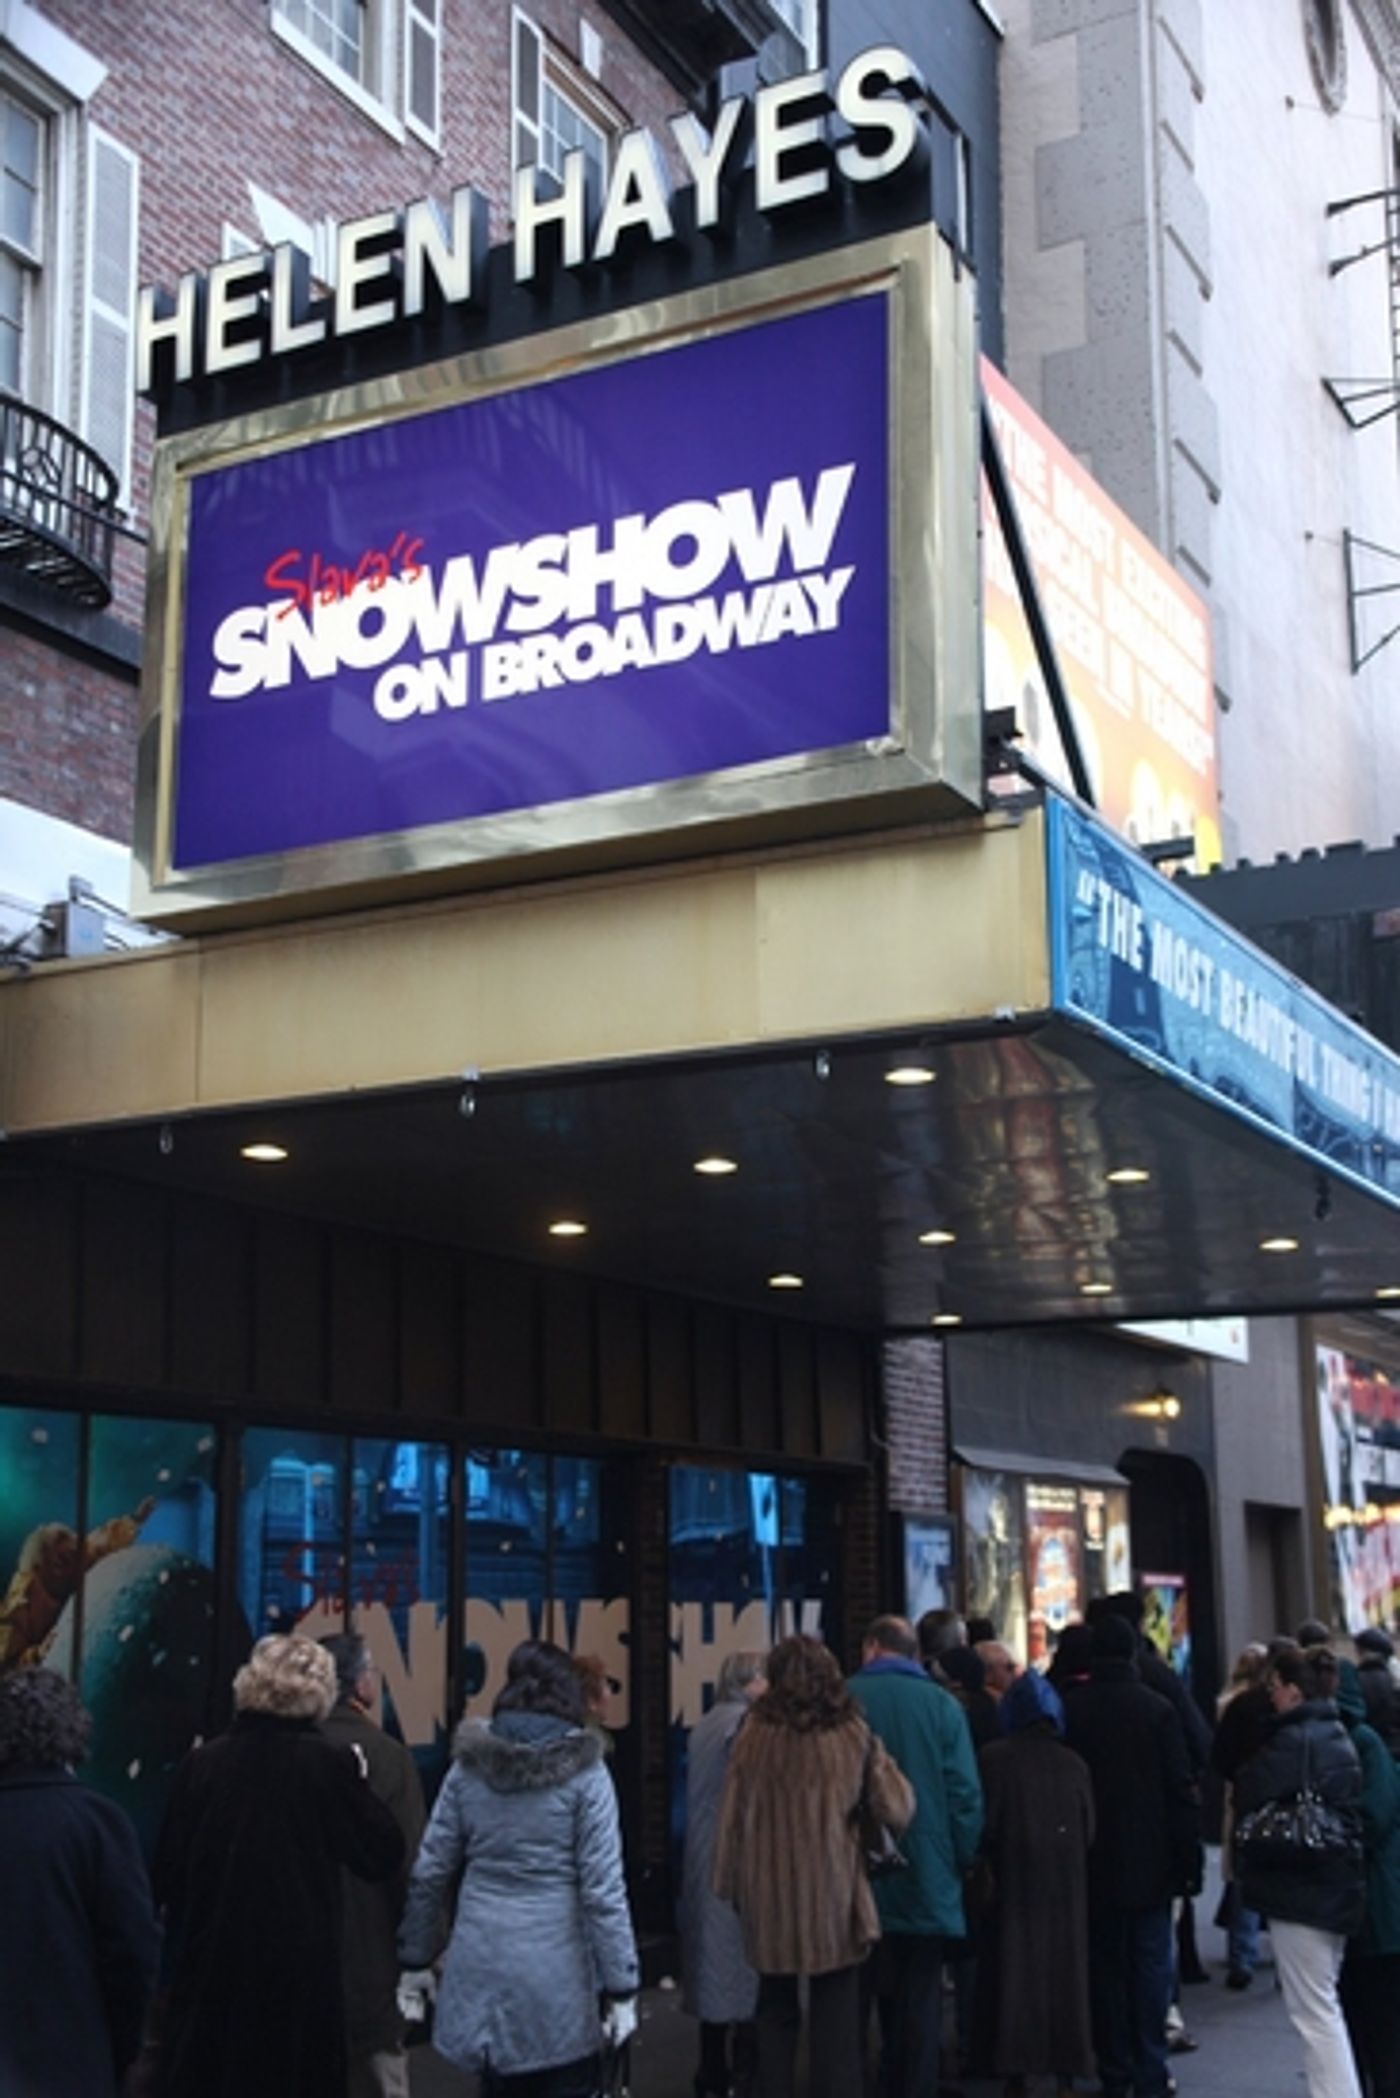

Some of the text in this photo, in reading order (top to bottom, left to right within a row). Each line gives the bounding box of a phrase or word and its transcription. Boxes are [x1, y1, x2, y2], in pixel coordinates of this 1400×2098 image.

[136, 46, 921, 392] HELEN HAYES
[209, 463, 857, 699] SNOWSHOW
[265, 533, 424, 621] Slava's
[373, 565, 857, 722] ON BROADWAY
[1151, 919, 1215, 1017] MOST
[1220, 969, 1316, 1091] BEAUTIFUL
